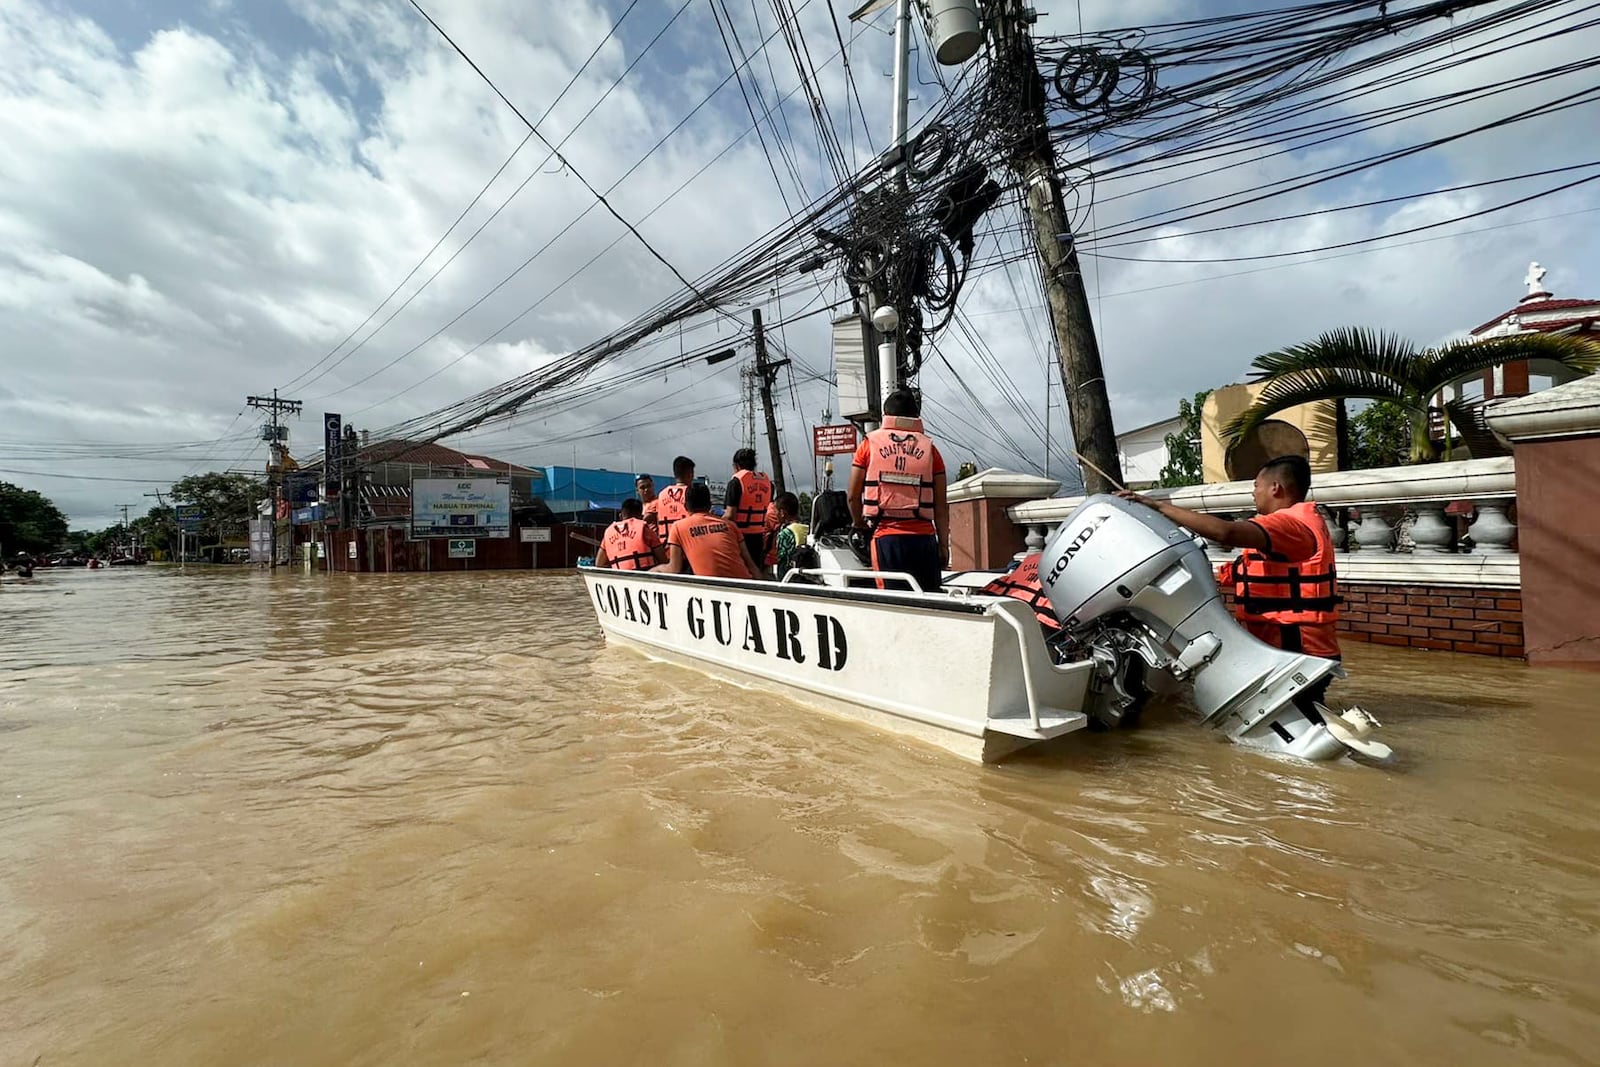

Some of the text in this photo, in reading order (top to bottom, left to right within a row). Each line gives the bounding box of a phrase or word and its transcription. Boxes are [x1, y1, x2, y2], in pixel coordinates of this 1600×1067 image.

[879, 442, 925, 461] COAST GUARD
[689, 523, 729, 537] COAST GUARD
[1046, 515, 1111, 588] HONDA
[595, 582, 848, 671] COAST GUARD
